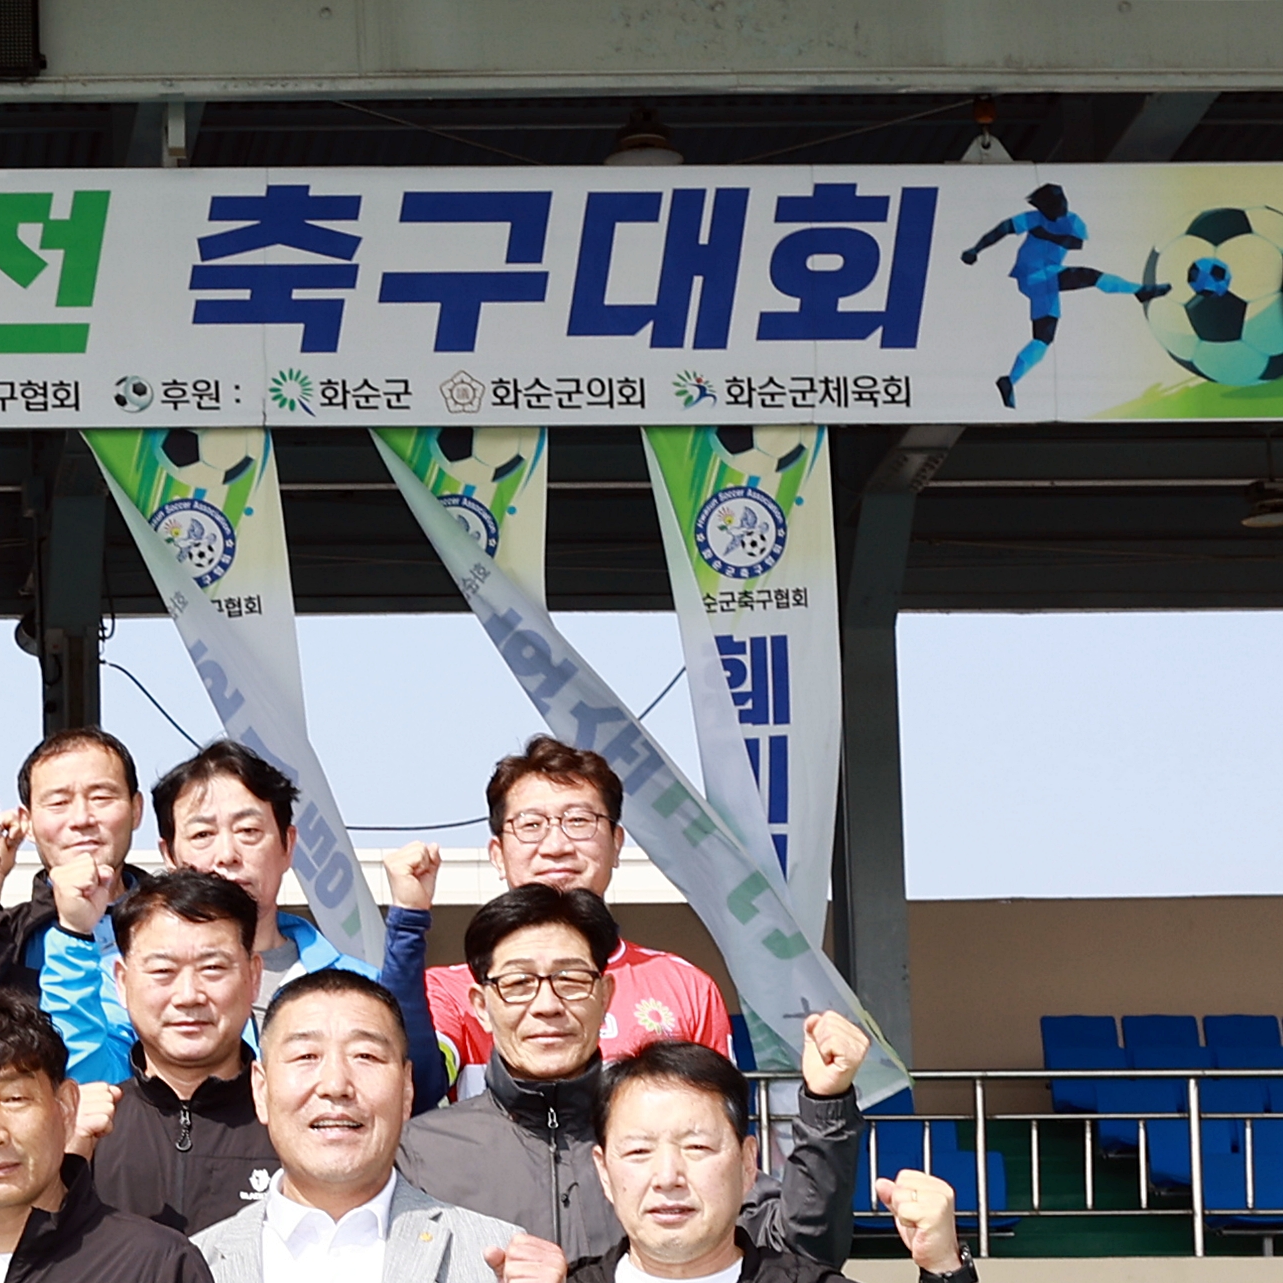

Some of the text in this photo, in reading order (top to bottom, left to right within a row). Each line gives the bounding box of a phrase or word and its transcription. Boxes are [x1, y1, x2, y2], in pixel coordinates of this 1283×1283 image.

[188, 182, 940, 354] 축구대회
[159, 378, 222, 412] 후원
[318, 376, 414, 410] 화순군
[490, 376, 647, 410] 화순군의회
[724, 375, 912, 409] 화순군체육회
